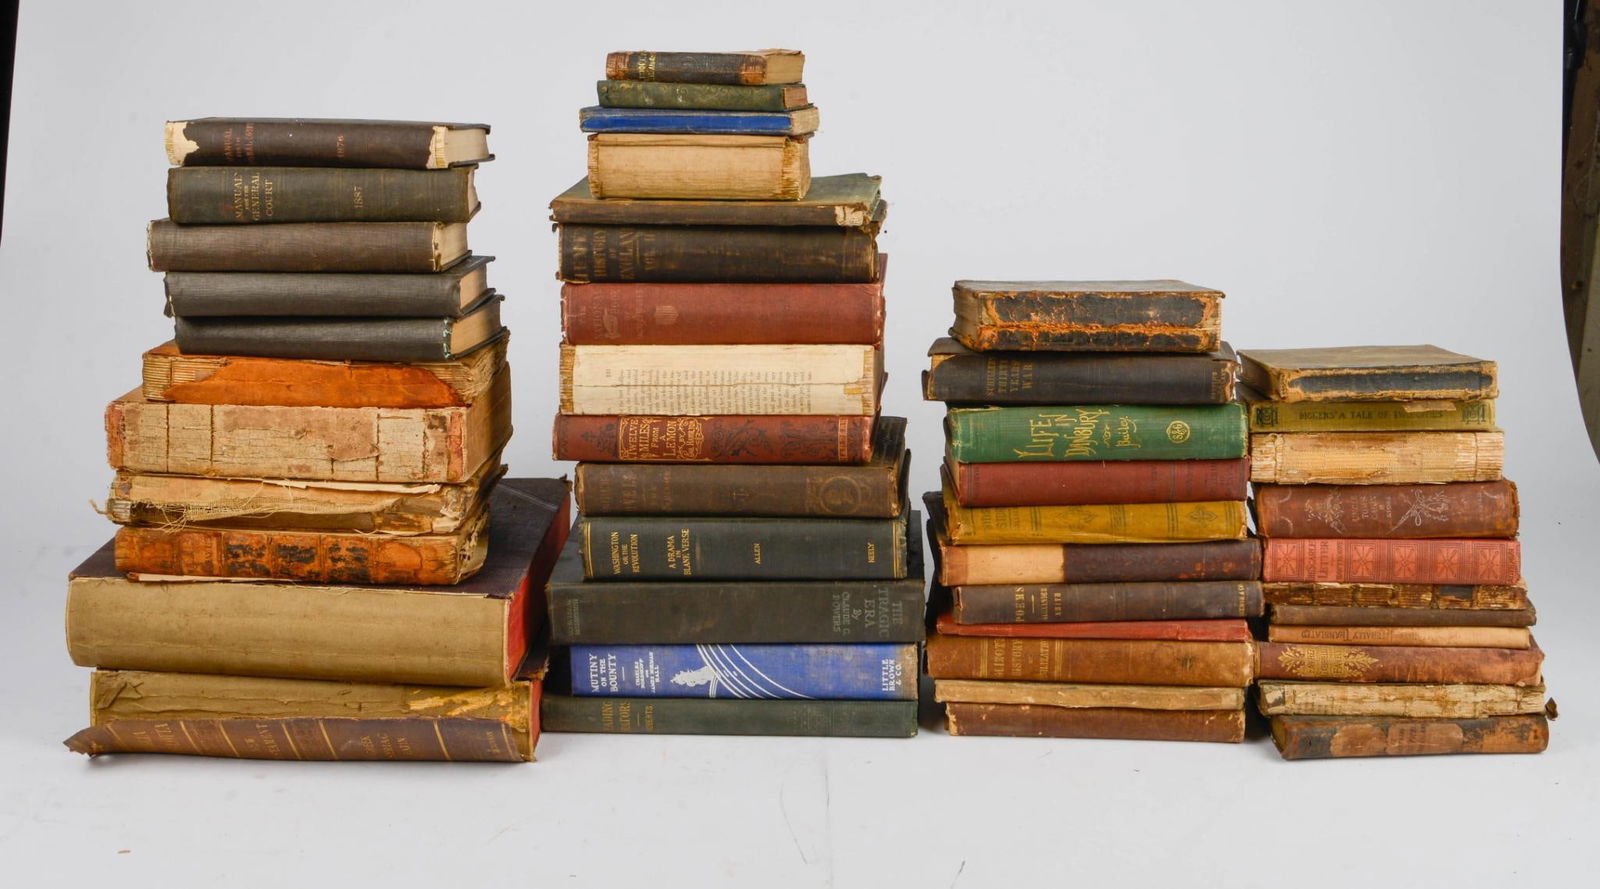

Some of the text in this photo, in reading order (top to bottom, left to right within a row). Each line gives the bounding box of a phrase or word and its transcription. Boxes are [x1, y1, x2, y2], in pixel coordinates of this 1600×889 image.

[233, 173, 243, 219] MANUAL
[251, 172, 260, 221] GENERAL
[264, 179, 273, 217] COURT
[1022, 362, 1033, 389] WAR
[1038, 412, 1077, 427] IN
[1063, 408, 1111, 458] DANBURY
[1338, 410, 1345, 419] A
[1351, 410, 1373, 420] TALE
[628, 419, 638, 455] TWELVE
[639, 423, 650, 452] MILES
[650, 427, 659, 448] FROM
[663, 420, 676, 456] LEMON
[1012, 417, 1060, 458] LIFE
[611, 531, 621, 575] WASHINGTON
[629, 533, 640, 573] REVOLUTION
[667, 535, 676, 562] DRAMA
[681, 528, 692, 576] BLANK VERSE
[1317, 541, 1328, 579] LETTER
[832, 592, 841, 633] BOWERS
[841, 591, 850, 625] CLAUDE
[864, 598, 876, 629] ERA
[878, 587, 889, 638] TRAGIC
[892, 600, 903, 625] THE
[1014, 586, 1025, 622] POEMS
[589, 653, 601, 693] MUTINY
[607, 652, 619, 693] BOUNTY
[881, 658, 889, 692] LITTLE
[888, 658, 896, 692] BROWN
[1012, 639, 1023, 677] HISTORY
[600, 676, 607, 687] ON
